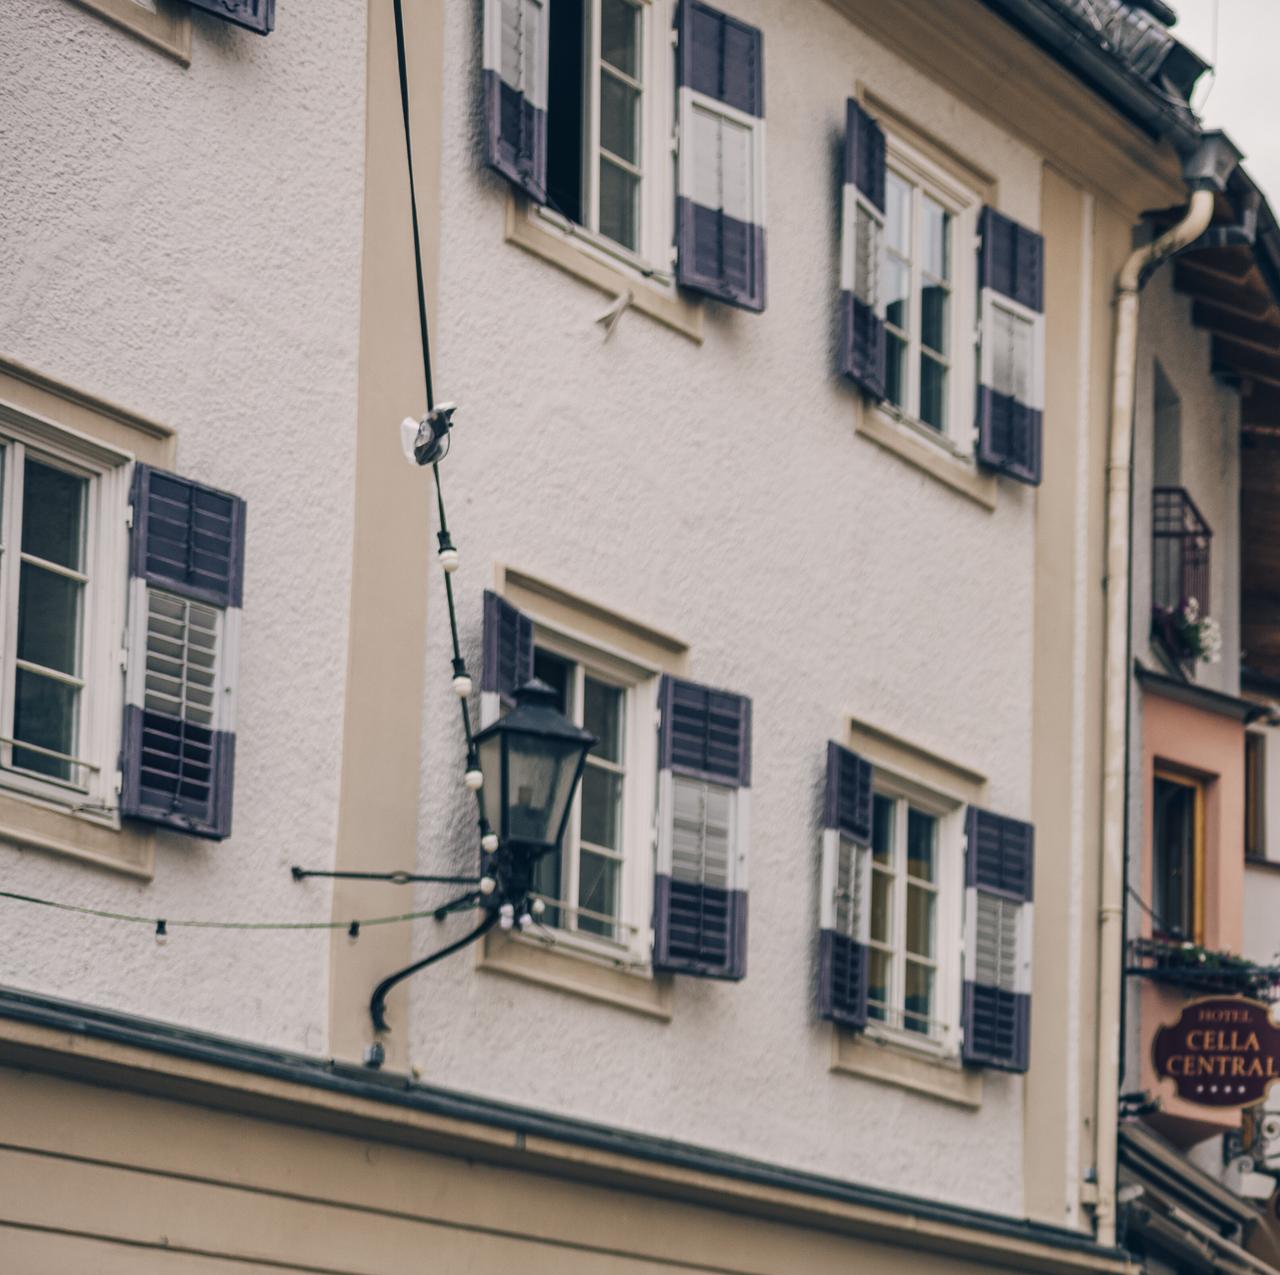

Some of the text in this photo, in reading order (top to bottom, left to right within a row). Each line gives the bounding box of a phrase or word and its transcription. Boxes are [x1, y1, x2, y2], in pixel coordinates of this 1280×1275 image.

[1199, 1009, 1252, 1022] HOTEL
[1186, 1029, 1260, 1051] CELLA
[1166, 1055, 1279, 1077] CENTRAL
